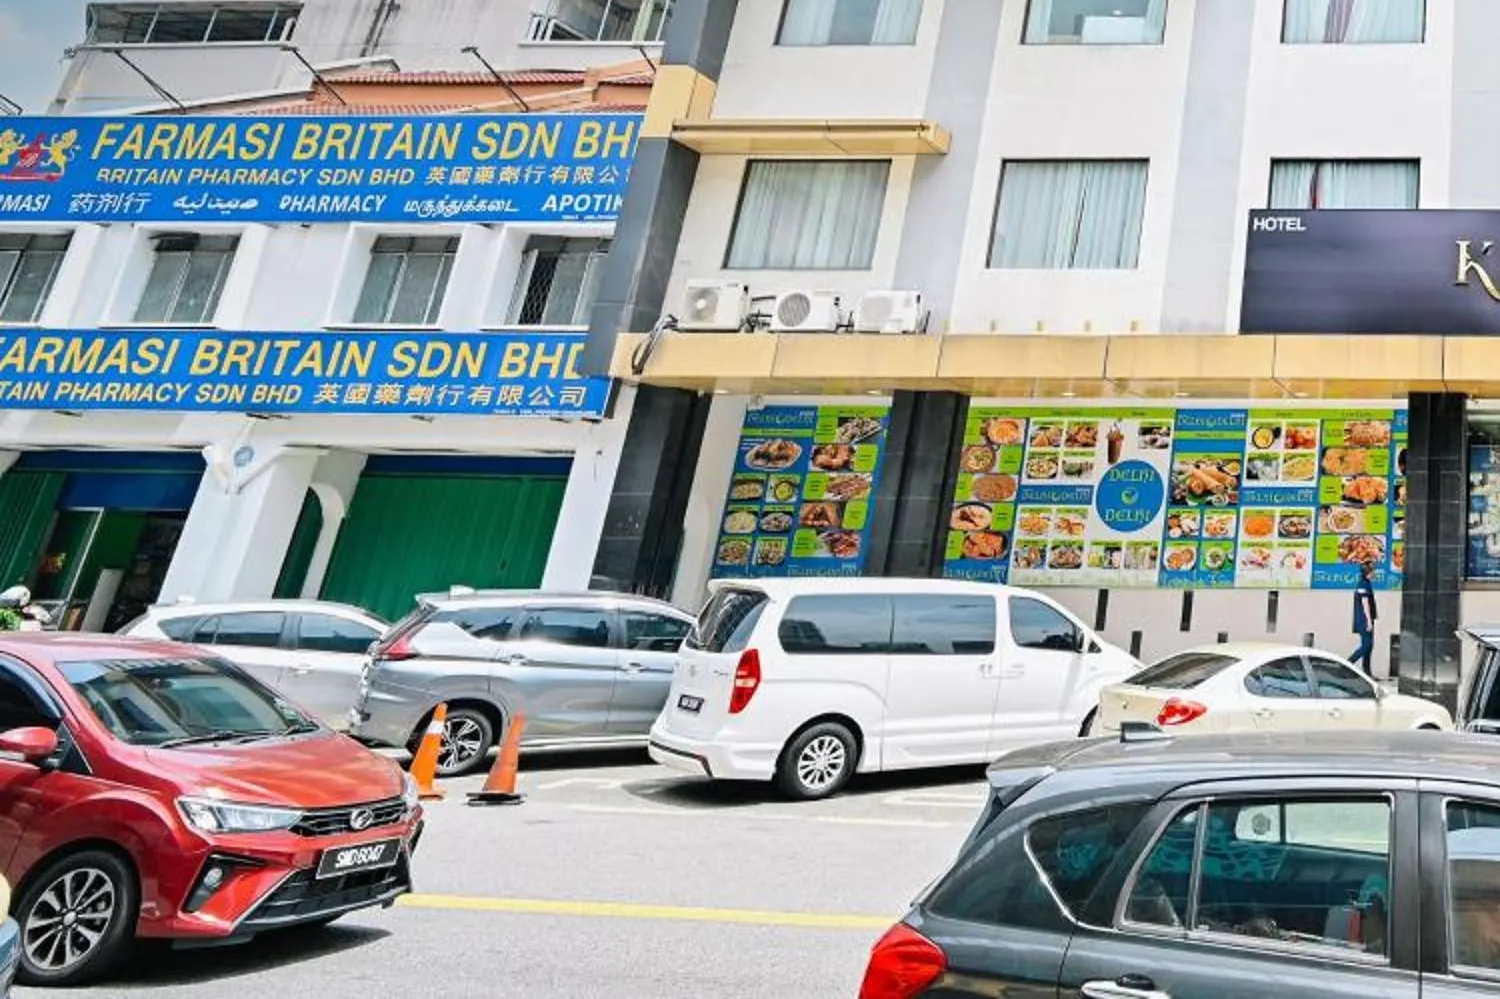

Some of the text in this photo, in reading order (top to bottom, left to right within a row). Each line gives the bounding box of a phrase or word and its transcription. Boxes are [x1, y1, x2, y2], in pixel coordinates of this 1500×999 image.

[91, 121, 637, 161] FARMASI BRITAIN SDN BH
[96, 167, 416, 186] BRITAIN PHARMACY SDN BHD
[424, 165, 630, 186] 英國藥劑行有限公
[279, 192, 387, 212] PHARMACY
[1253, 216, 1307, 231] HOTEL
[0, 337, 181, 375] ARMASI
[189, 339, 377, 378] BRITAIN
[387, 340, 488, 379] SDN
[54, 381, 191, 403] PHARMACY
[195, 383, 252, 404] SDN
[251, 384, 303, 404] BHD
